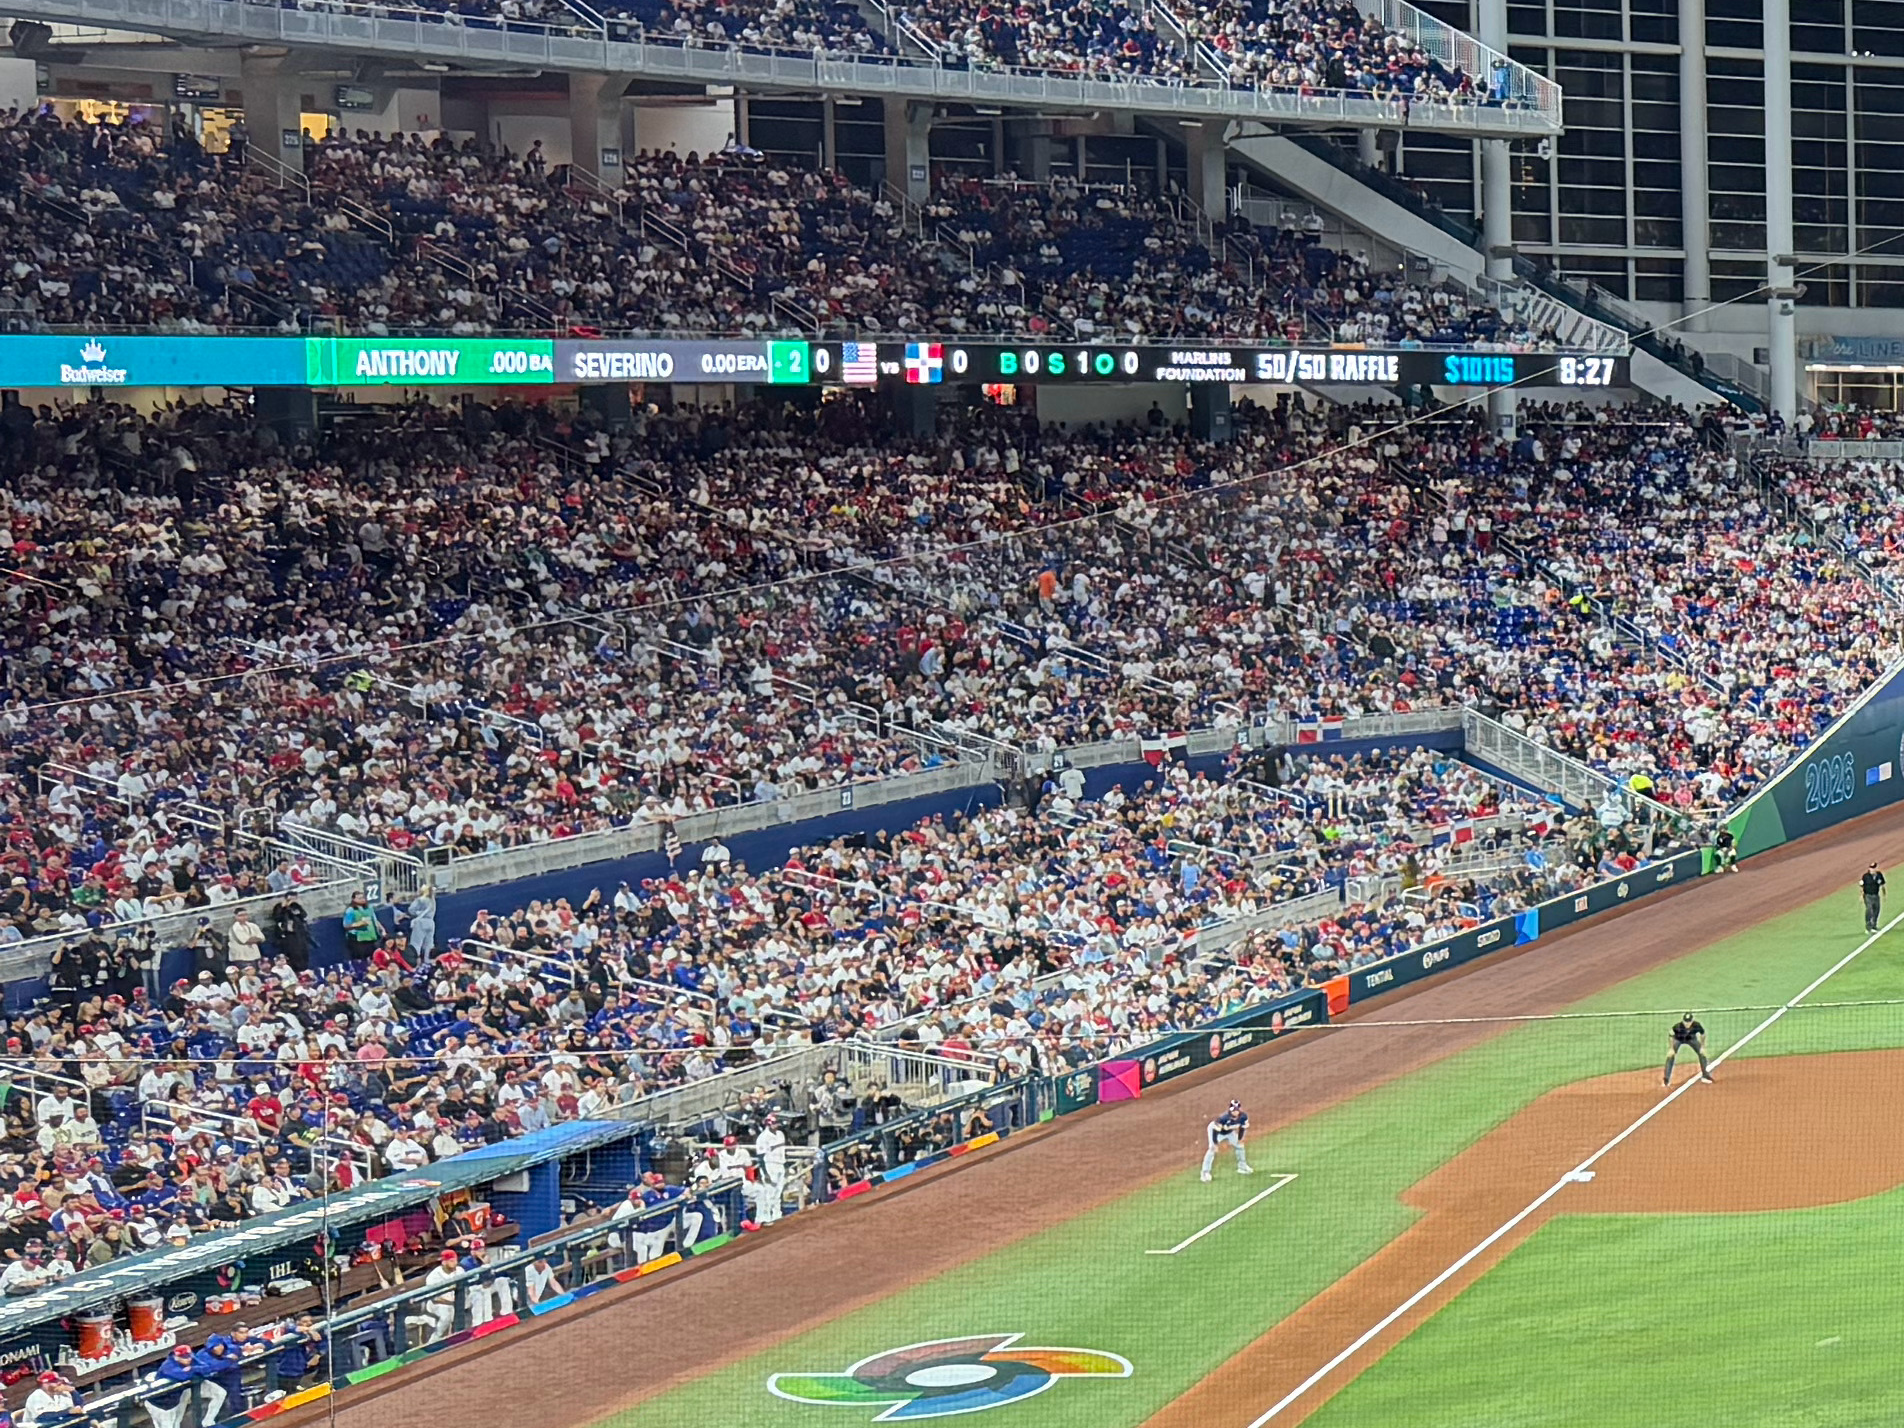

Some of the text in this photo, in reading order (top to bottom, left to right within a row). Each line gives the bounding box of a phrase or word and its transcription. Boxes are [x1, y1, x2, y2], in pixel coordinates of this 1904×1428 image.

[355, 349, 527, 376] ANTHONY .000
[575, 352, 674, 378] SEVERINO
[1171, 351, 1231, 366] MARLINS
[1257, 350, 1399, 383] 50/50 RAFFLE
[1445, 355, 1514, 384] $10115
[1560, 357, 1615, 386] 8:27
[60, 364, 127, 383] Budweiser
[1156, 367, 1246, 382] FOUNDATION
[1804, 751, 1856, 813] 2026
